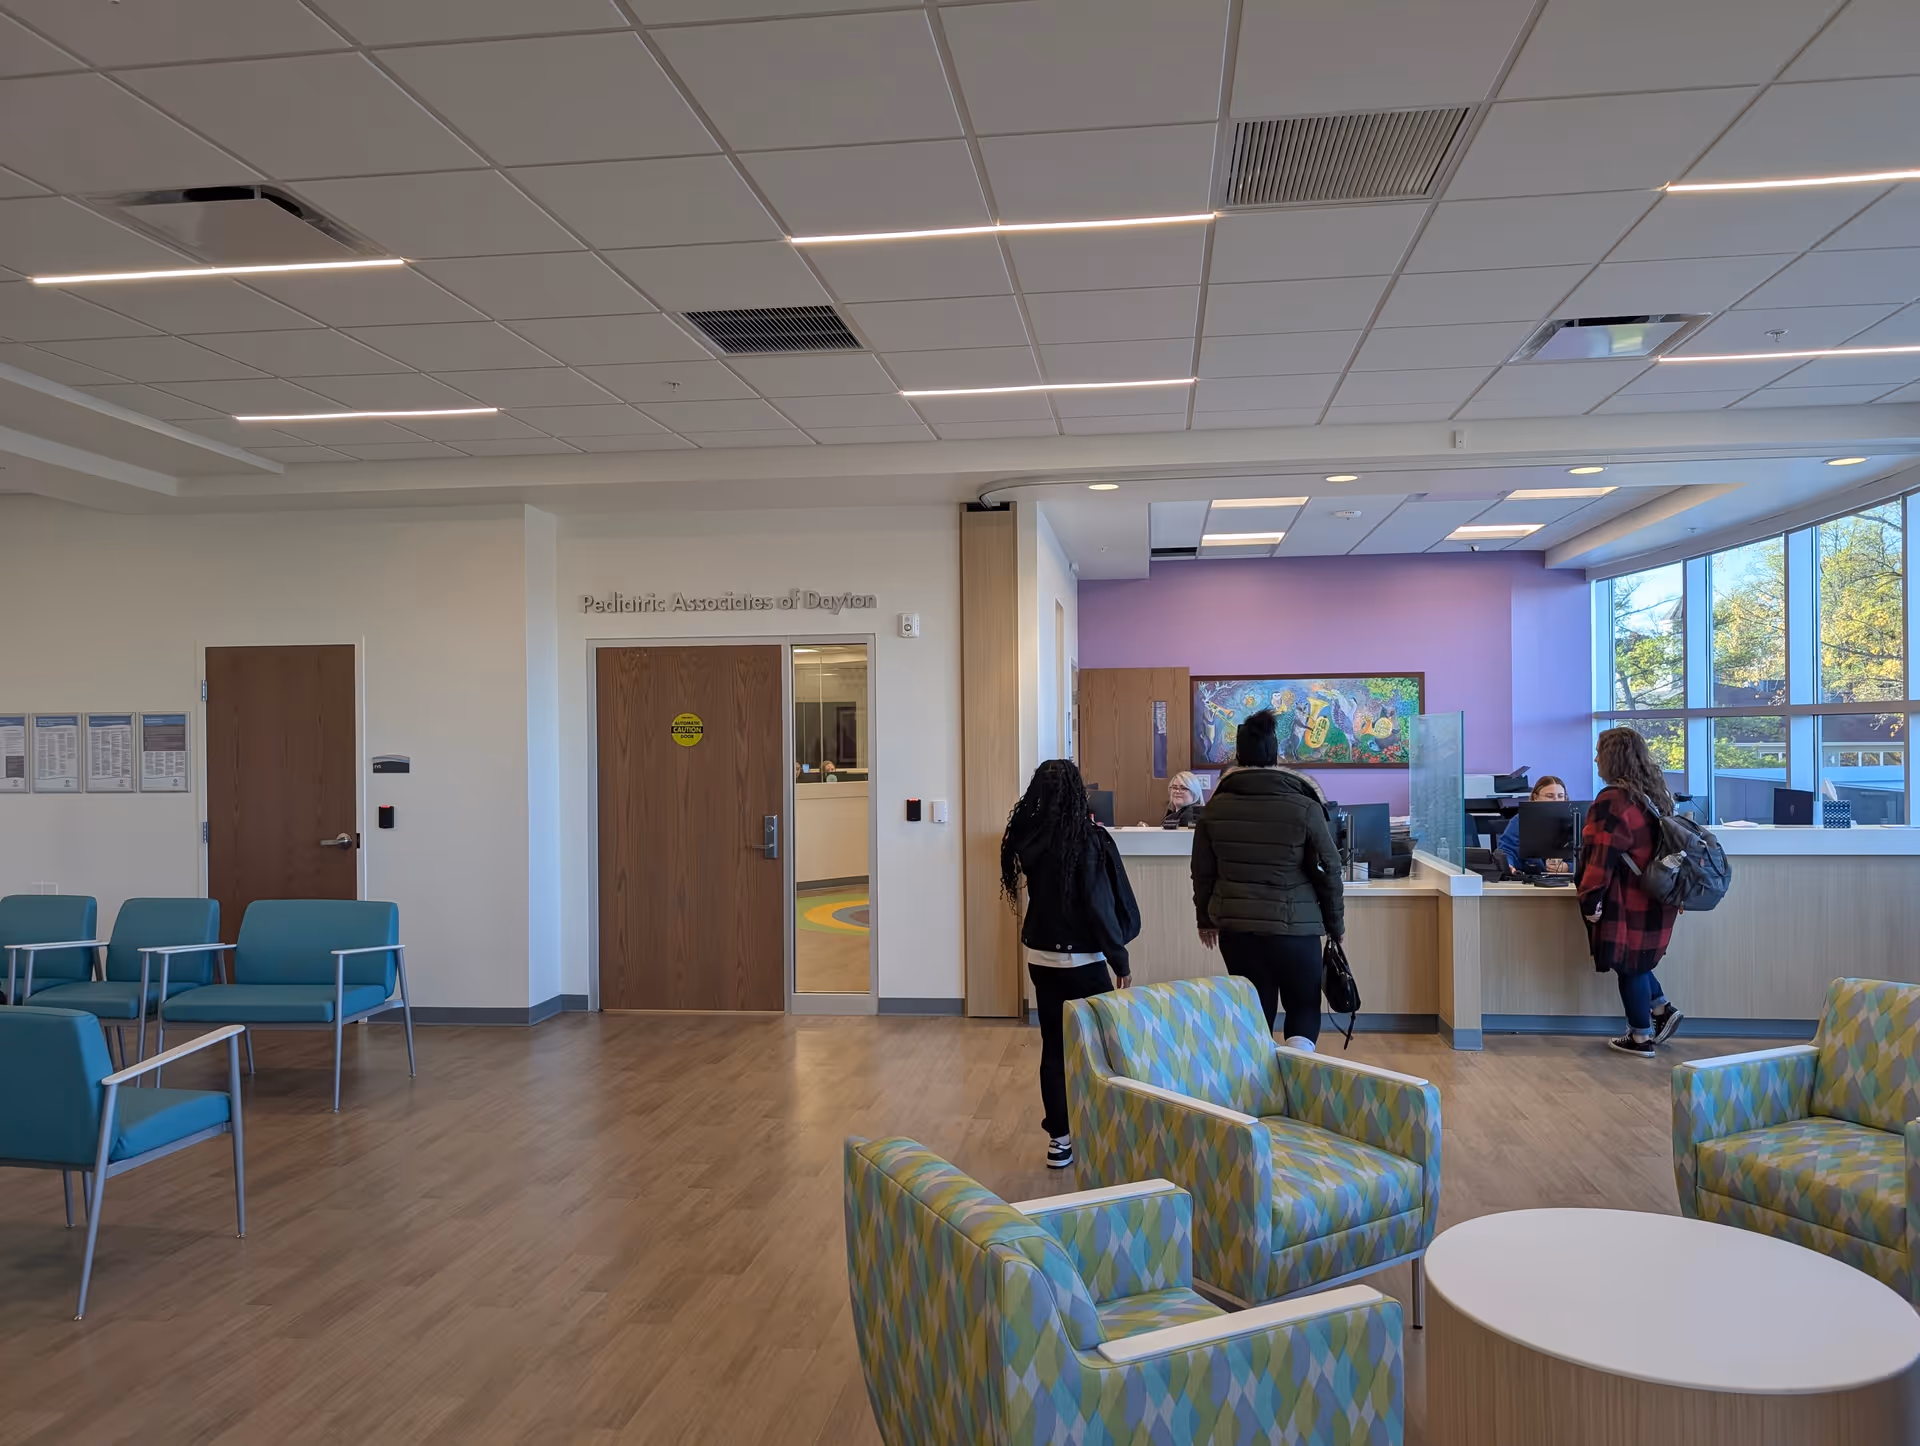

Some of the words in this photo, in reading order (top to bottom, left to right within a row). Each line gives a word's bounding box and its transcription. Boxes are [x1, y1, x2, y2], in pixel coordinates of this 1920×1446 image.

[583, 591, 666, 613] Pediatric
[672, 590, 774, 612] Associates
[779, 589, 800, 609] of
[804, 590, 877, 615] Dayton
